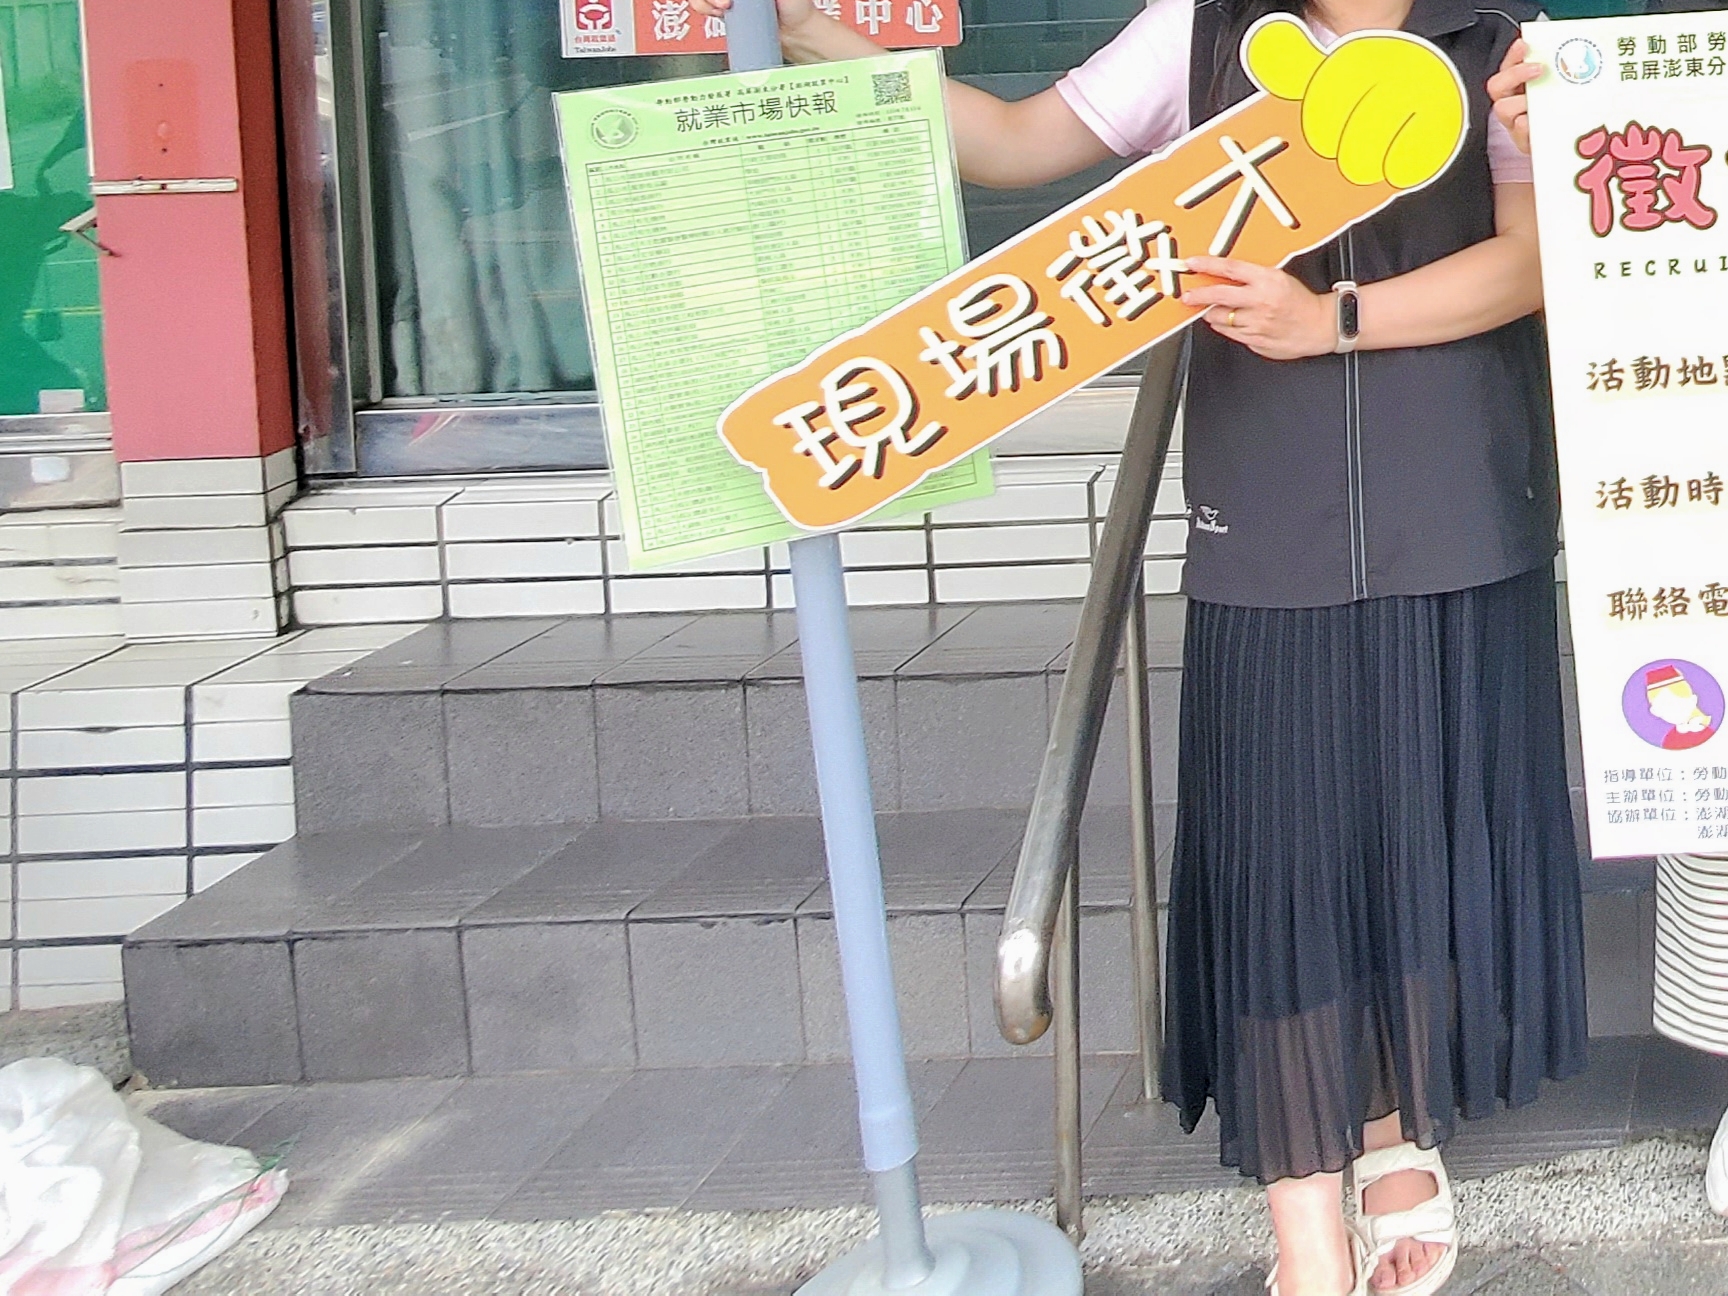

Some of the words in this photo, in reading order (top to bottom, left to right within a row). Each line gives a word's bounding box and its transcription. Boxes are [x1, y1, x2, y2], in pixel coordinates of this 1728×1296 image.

[674, 90, 838, 133] 就業市場快報
[773, 134, 1300, 491] 現場徵才
